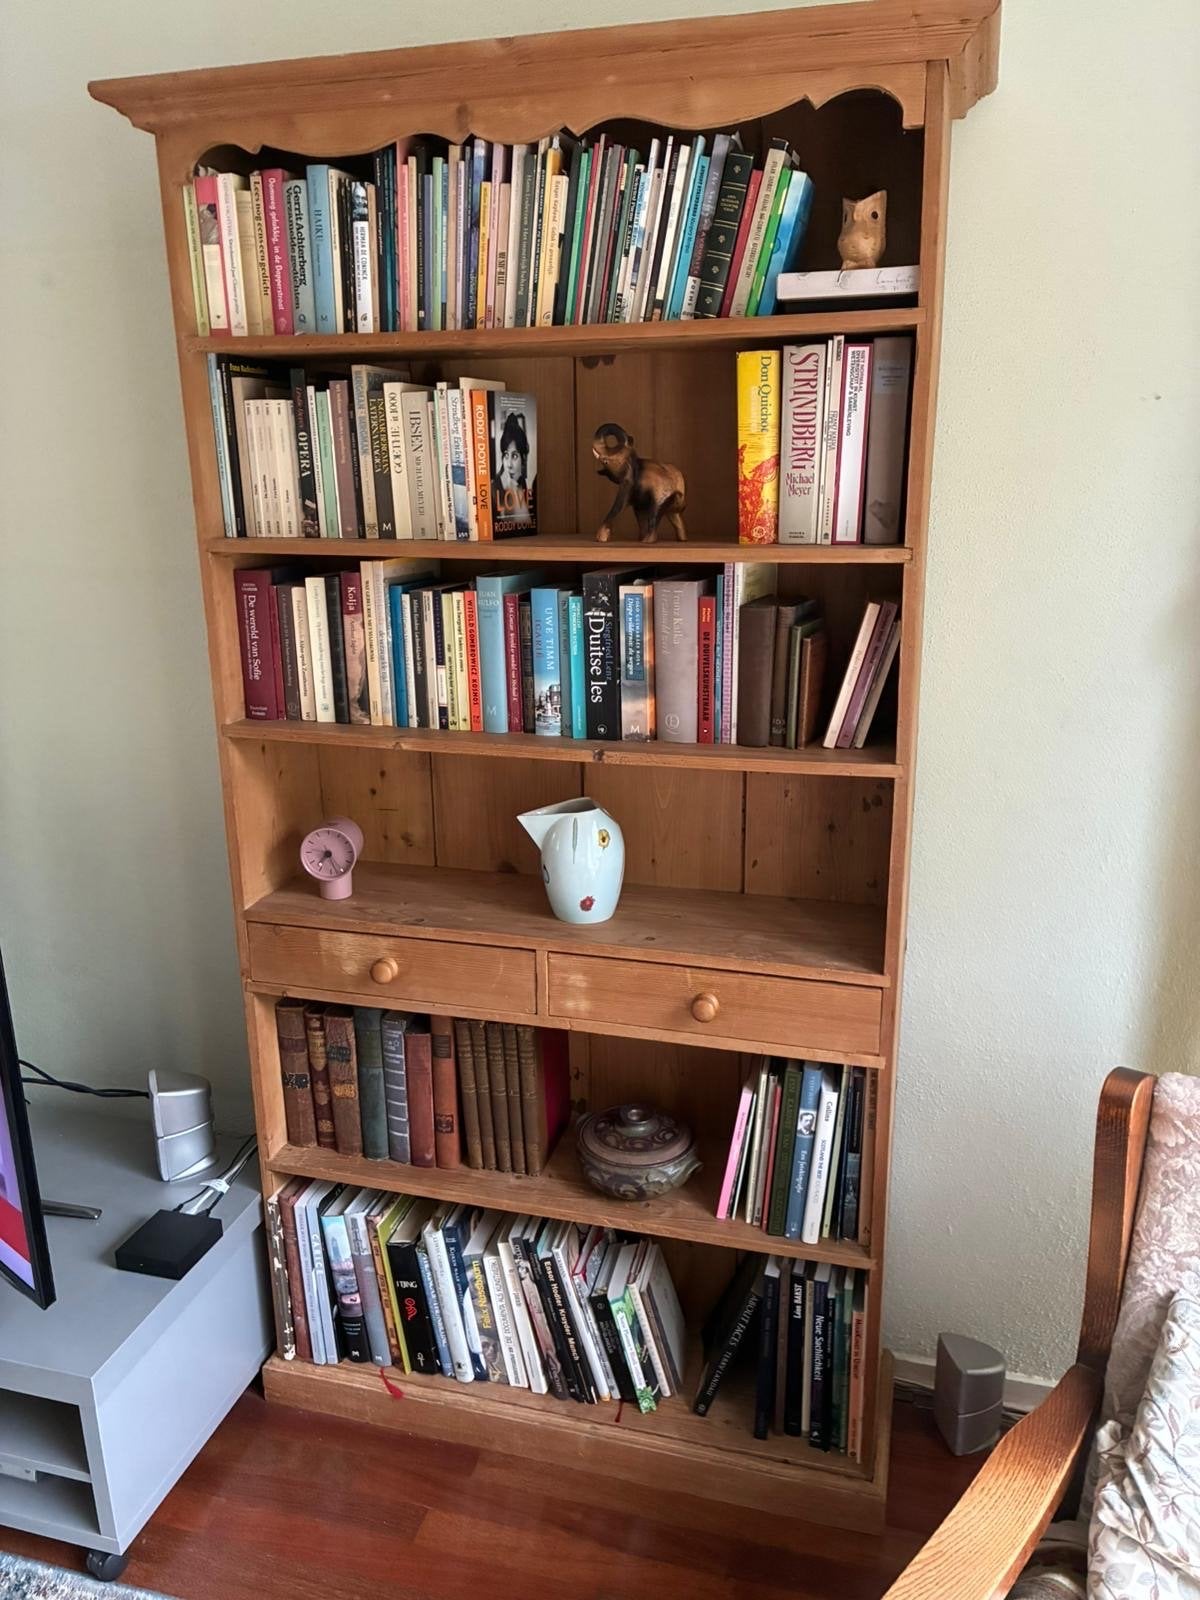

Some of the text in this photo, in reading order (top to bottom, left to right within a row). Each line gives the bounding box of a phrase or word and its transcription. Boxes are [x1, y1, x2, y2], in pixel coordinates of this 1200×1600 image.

[268, 178, 277, 209] Domweg
[254, 204, 262, 221] nog
[258, 262, 270, 296] gedicht
[286, 187, 301, 310] Verzamelde gedichten
[293, 185, 307, 286] Gerrit Achterberg
[314, 209, 323, 242] HAIKU
[274, 255, 281, 263] de
[274, 266, 285, 310] Dapperstraat
[687, 278, 697, 307] POEMS
[757, 356, 772, 433] Don Quichot
[857, 364, 865, 393] NORMAAL
[369, 398, 382, 473] LATERNA MAGICA
[377, 398, 389, 474] INGMAR BERGMAN
[789, 352, 819, 470] STRINDBERG
[297, 431, 311, 477] OPERA
[409, 411, 425, 516] IBSEN MICHAEL MEYER
[476, 405, 488, 510] RODDY DOYLE LOVE
[496, 489, 533, 512] LOVE
[787, 485, 811, 497] Meyer
[347, 587, 356, 611] Kolja
[626, 598, 634, 616] Diepe
[672, 589, 684, 644] Franz Kafka
[248, 595, 261, 680] De wereld van Sofie
[468, 628, 477, 675] GOMBROWICZ
[544, 607, 554, 671] UWE TIMM
[588, 617, 607, 703] Duitse les
[603, 621, 613, 681] Siegfried Lenz
[702, 632, 710, 721] DE DUIVELSKUNSTENAAR
[824, 1101, 833, 1122] Collins
[818, 1139, 826, 1161] SCOTLAND
[481, 1307, 492, 1329] Felix
[544, 1261, 580, 1361] Ensor Hodler Kruyder Munch
[741, 1295, 759, 1323] ABOUT
[728, 1324, 747, 1348] FACES
[813, 1315, 825, 1381] Neue Sachlichkeit
